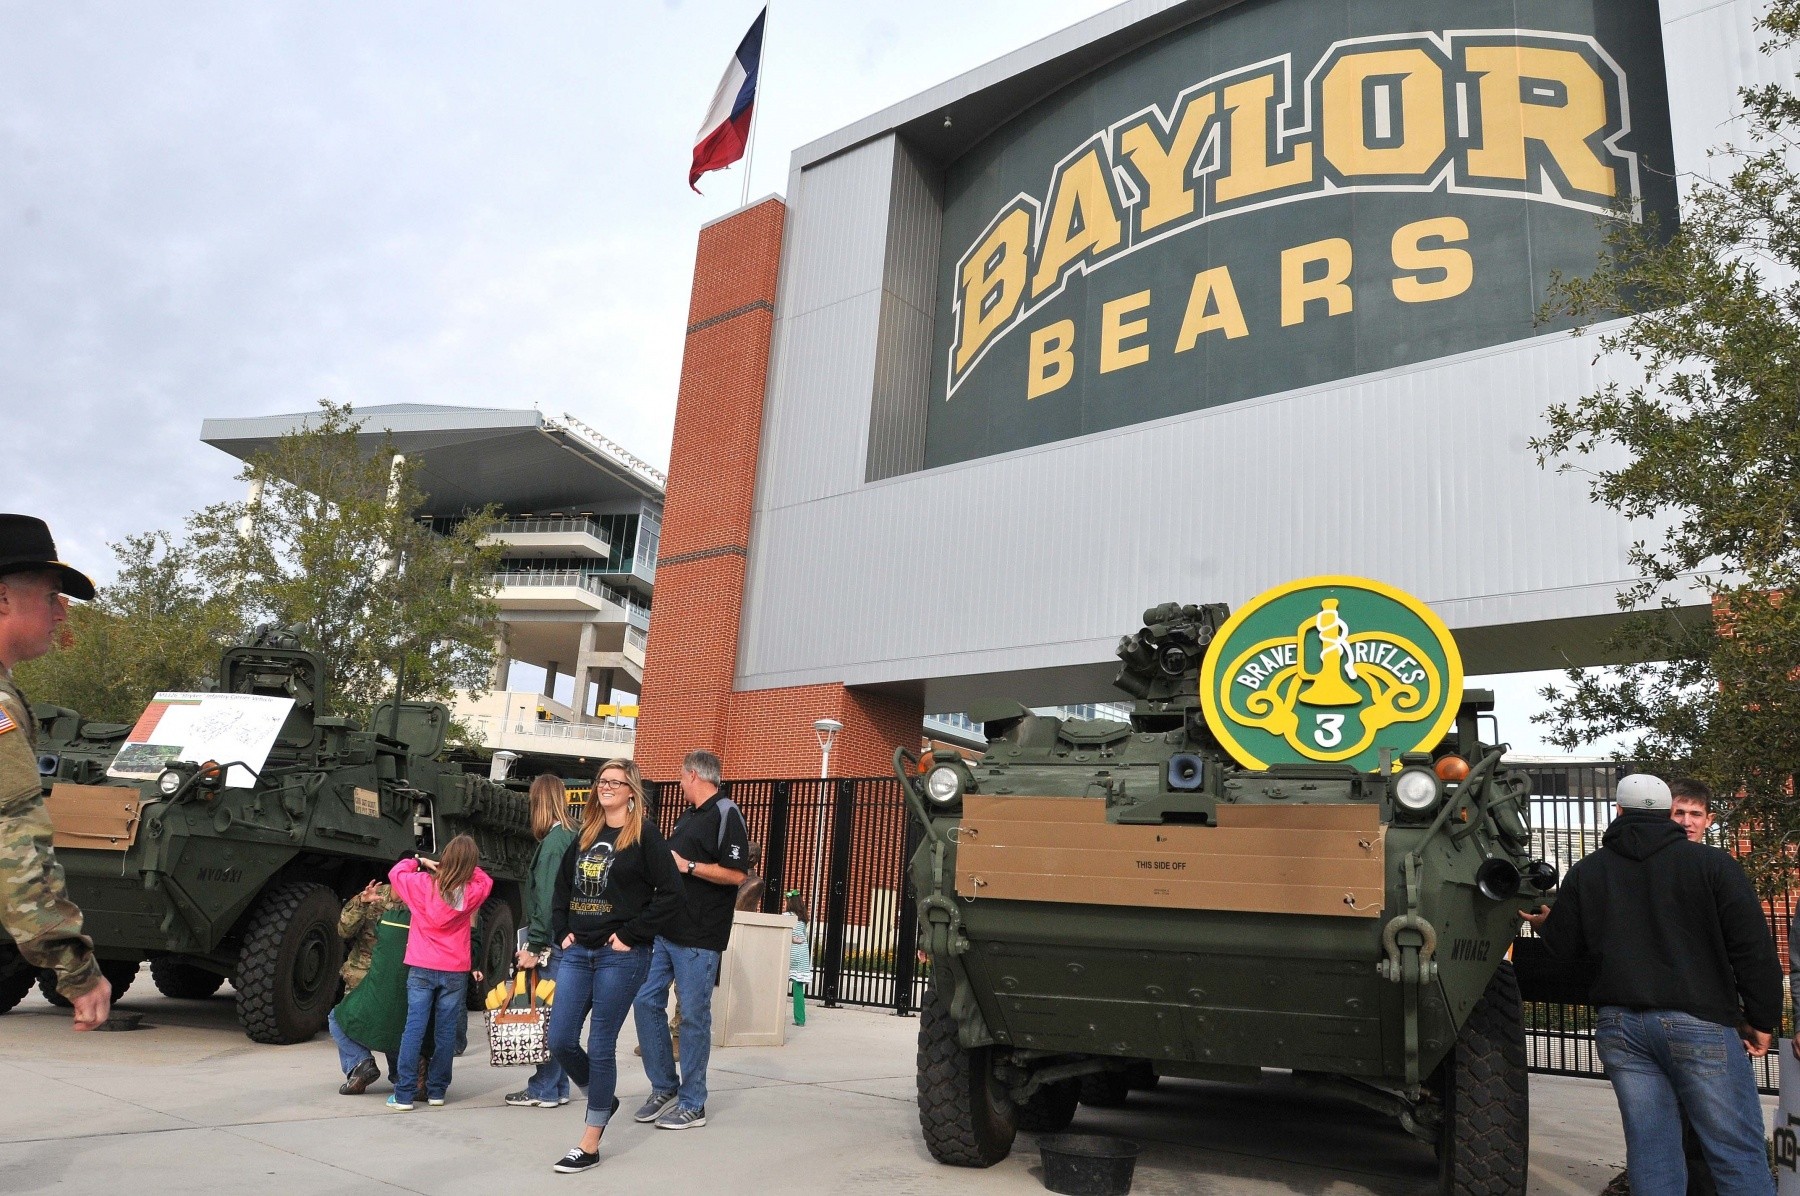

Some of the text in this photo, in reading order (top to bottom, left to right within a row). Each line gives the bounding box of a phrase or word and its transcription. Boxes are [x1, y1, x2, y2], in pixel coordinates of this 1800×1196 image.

[948, 30, 1642, 400] BAYLOR
[1027, 216, 1474, 400] BEARS
[1236, 642, 1426, 690] BRAVE RIFLES
[1314, 713, 1345, 748] 3
[1136, 861, 1187, 870] THIS SIDE OFF
